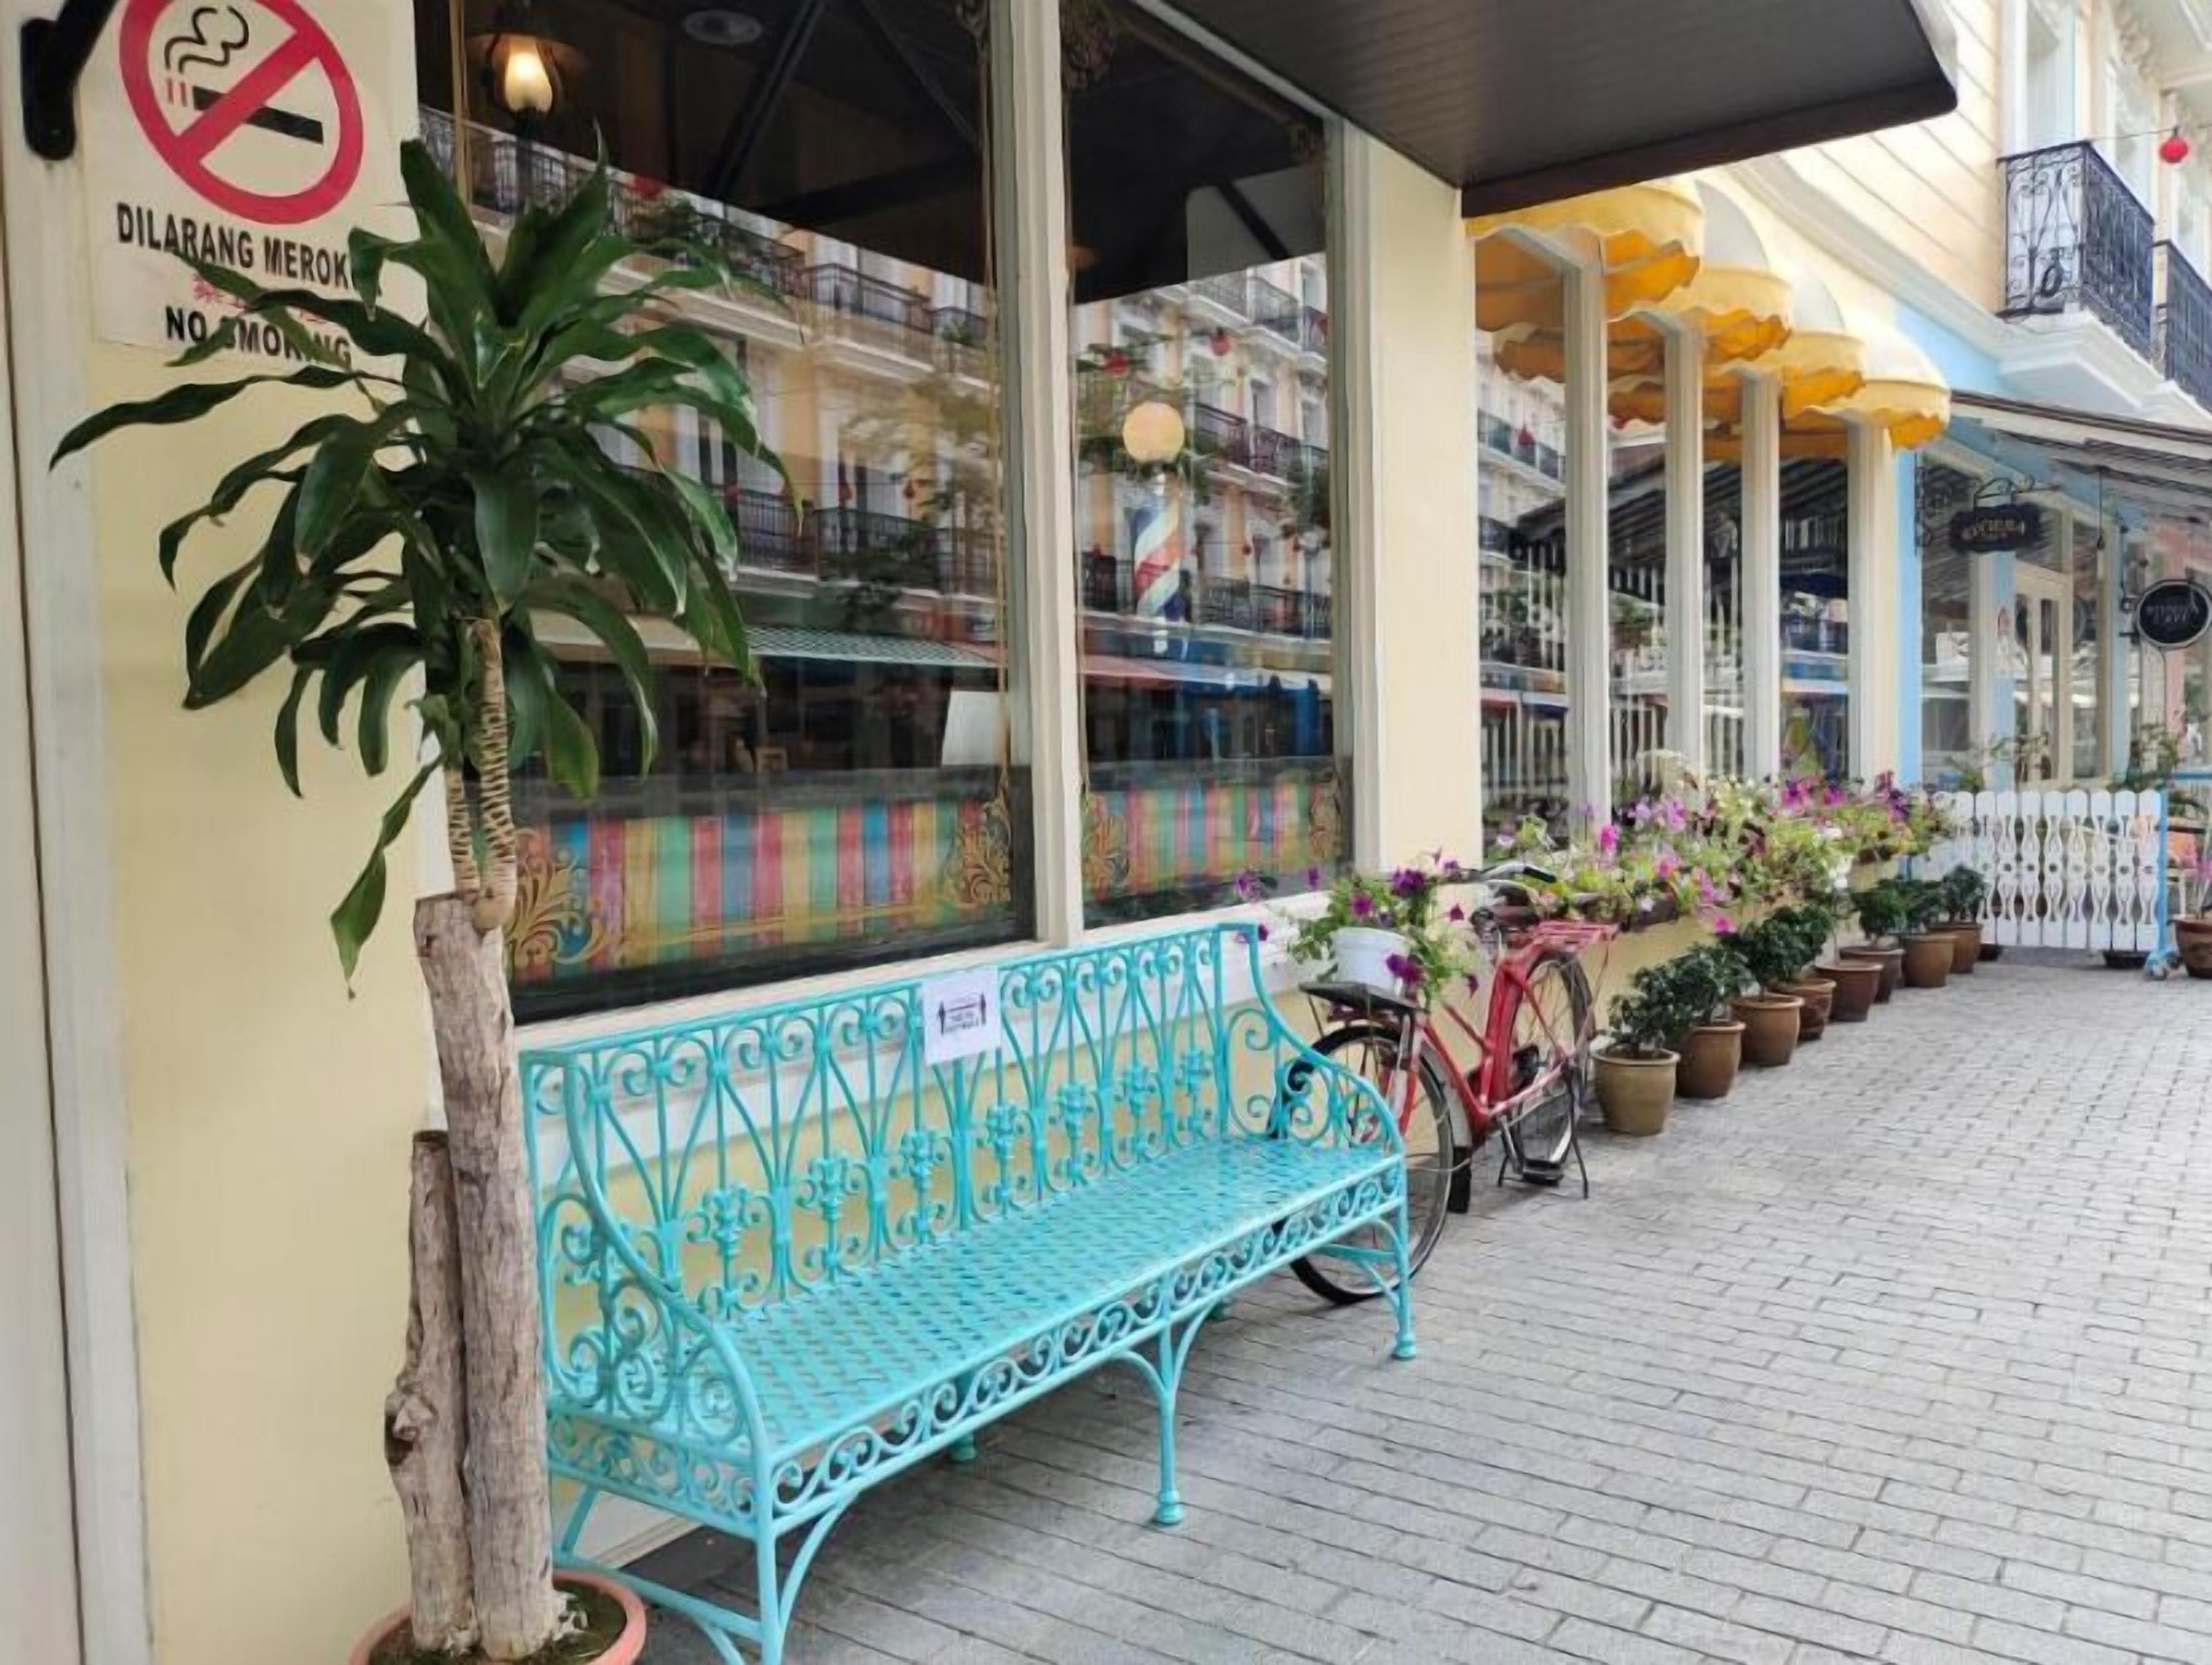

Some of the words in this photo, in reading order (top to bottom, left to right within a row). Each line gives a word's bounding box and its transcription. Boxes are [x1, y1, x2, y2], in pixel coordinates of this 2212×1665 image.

[117, 202, 253, 269] DILARANG
[263, 235, 382, 297] MEROK
[165, 305, 207, 343] NO
